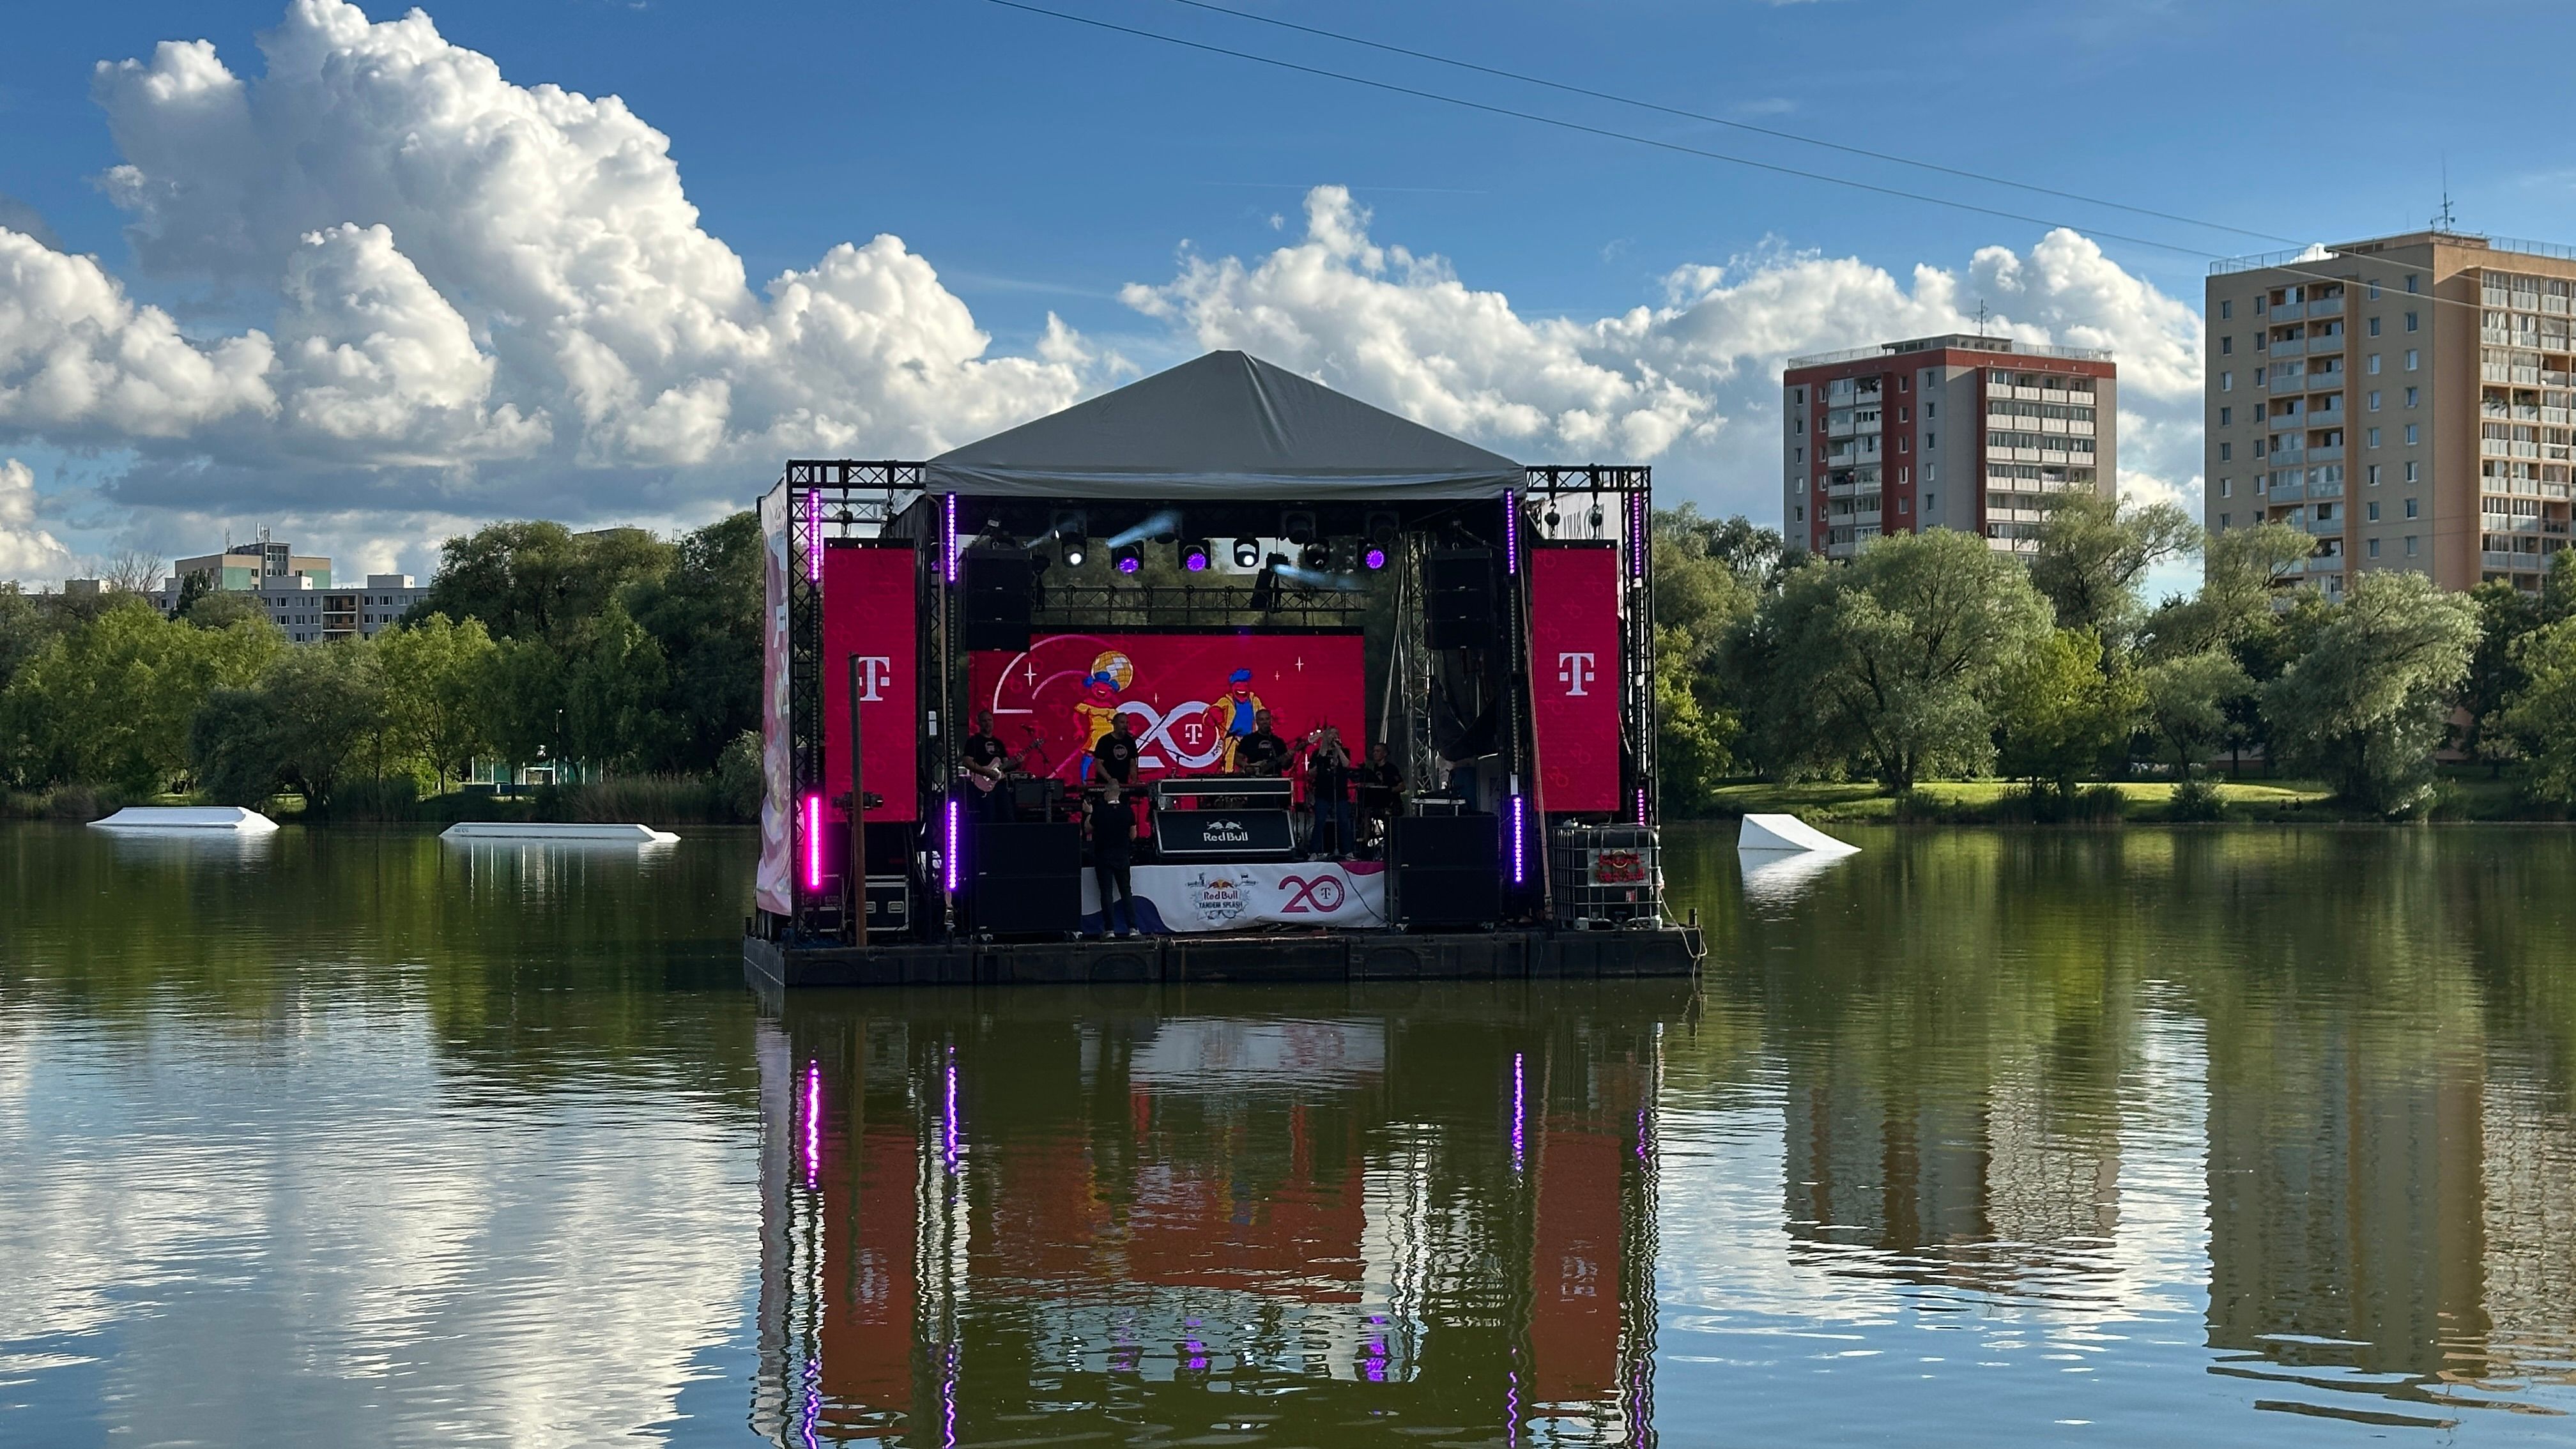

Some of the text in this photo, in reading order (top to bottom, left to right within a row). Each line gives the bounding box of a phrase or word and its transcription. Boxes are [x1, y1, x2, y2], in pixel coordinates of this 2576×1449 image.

[859, 657, 889, 701] T
[1560, 653, 1595, 696] T
[1185, 724, 1202, 744] T
[1203, 832, 1248, 841] Red Bull
[1204, 891, 1238, 900] Red Bull
[1278, 875, 1345, 912] 20
[1321, 887, 1331, 900] T
